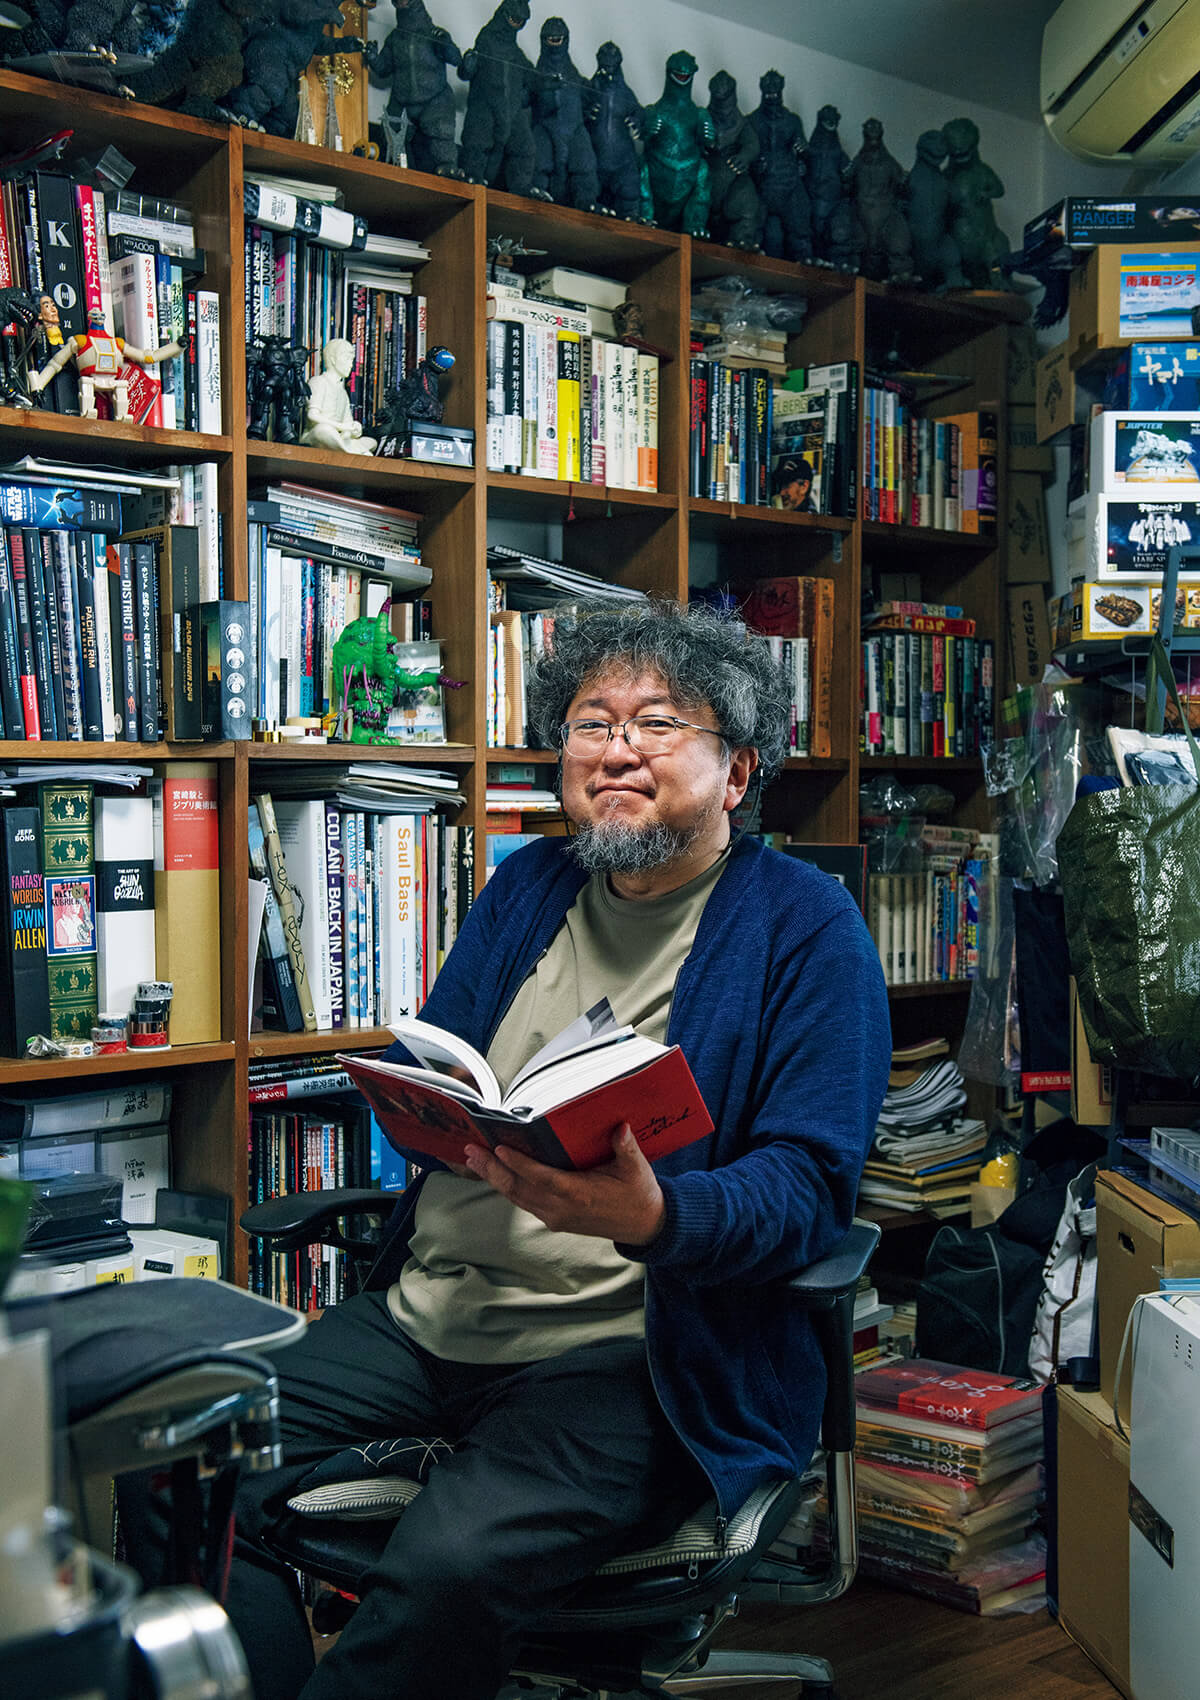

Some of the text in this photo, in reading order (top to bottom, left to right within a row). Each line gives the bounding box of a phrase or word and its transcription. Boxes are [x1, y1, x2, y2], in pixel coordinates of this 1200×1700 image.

[30, 207, 39, 239] Making
[1072, 211, 1136, 225] RANGER
[47, 220, 73, 248] K
[82, 202, 100, 290] まあだだよ
[53, 283, 77, 309] O
[1139, 355, 1184, 386] ヤマト
[10, 535, 27, 580] GODZILLA
[42, 536, 50, 567] MARVEL
[331, 545, 347, 559] Focus
[33, 591, 42, 636] TENET
[121, 580, 133, 631] DISTRICT
[52, 629, 58, 637] OF
[80, 616, 88, 659] UPRISING
[85, 606, 96, 668] PACIFIC RIM
[123, 633, 134, 641] 9
[173, 790, 204, 800] 宮崎駿と
[327, 811, 342, 875] COLANI
[11, 873, 43, 890] FANTASY
[119, 873, 140, 888] SHIN
[347, 874, 357, 888] 82
[398, 827, 412, 922] Saul Bass
[12, 888, 44, 904] WORLDS
[114, 884, 144, 901] GODZILLA
[13, 908, 45, 929] IRWIN
[329, 889, 343, 931] BACK
[15, 928, 46, 950] ALLEN
[331, 954, 345, 1010] JAPAN
[399, 1007, 409, 1017] K
